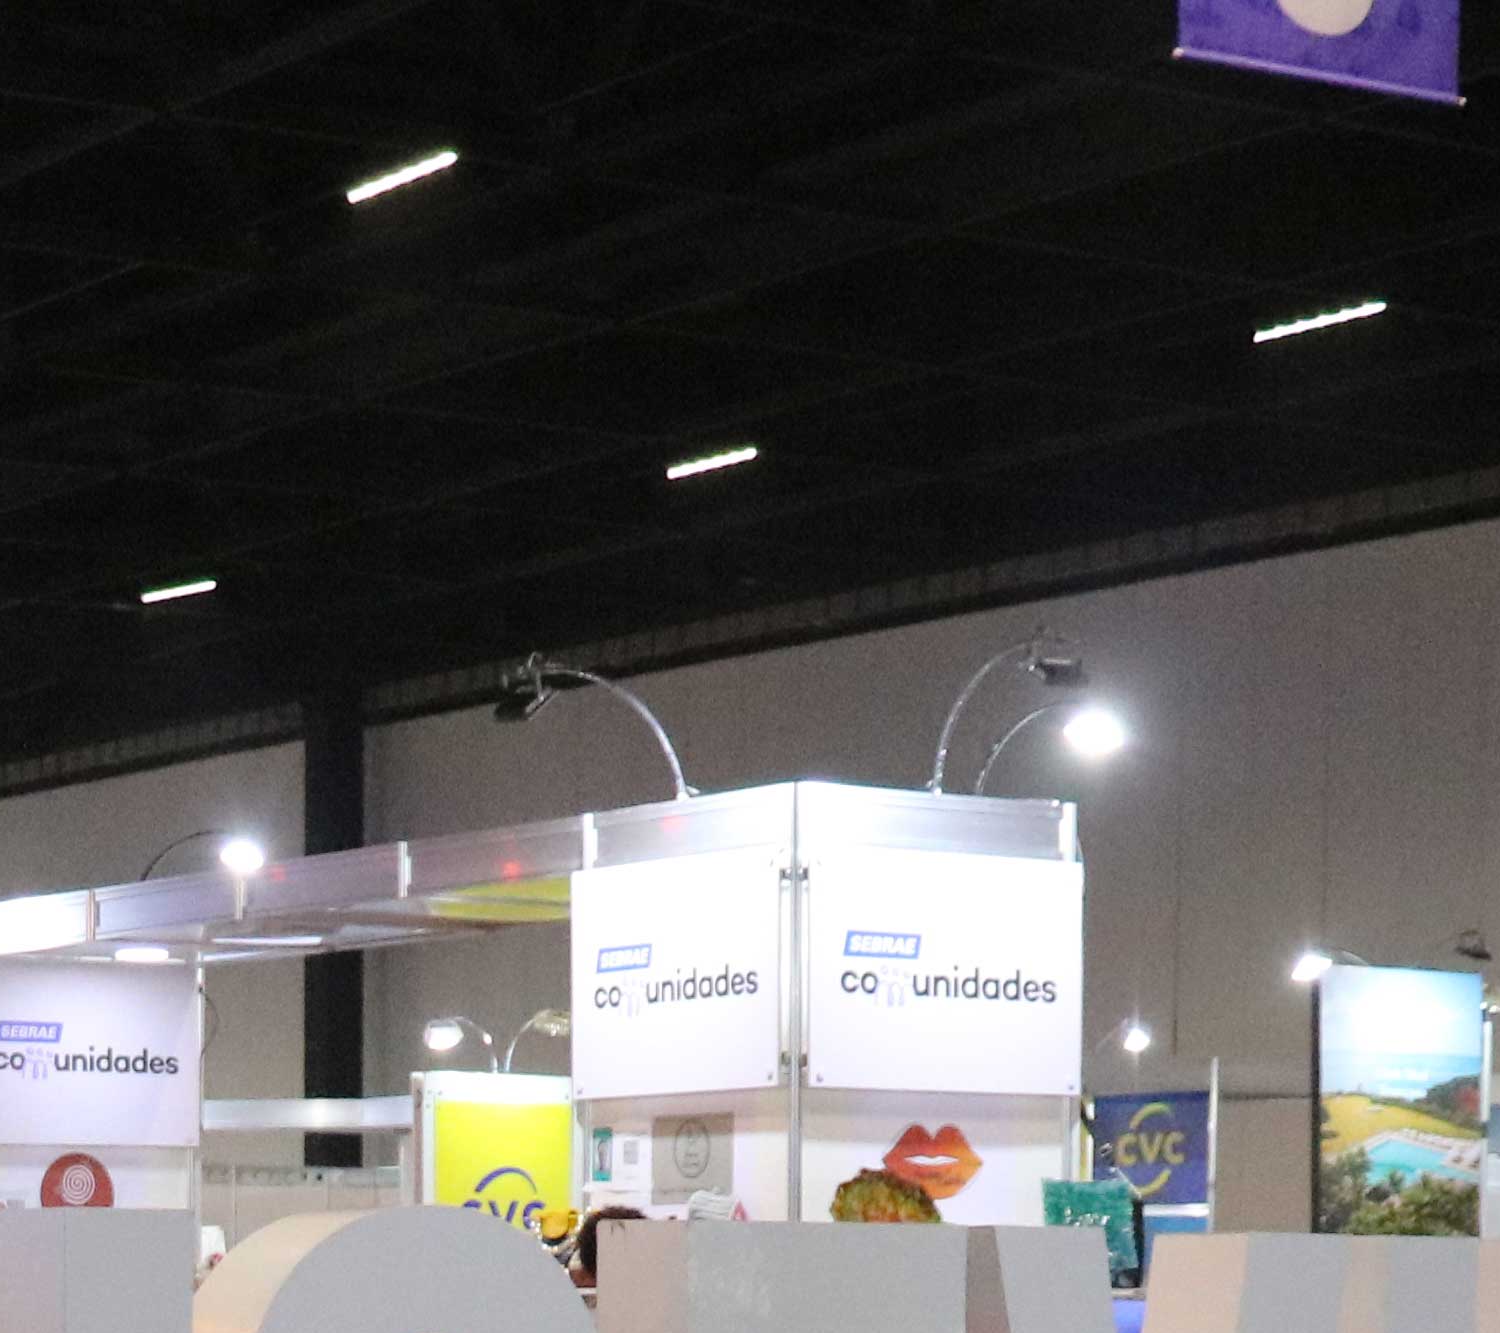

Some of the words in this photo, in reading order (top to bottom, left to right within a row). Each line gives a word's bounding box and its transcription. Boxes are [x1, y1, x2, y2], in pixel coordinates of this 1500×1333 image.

[848, 934, 918, 956] SEBRAE
[599, 947, 649, 969] SEBRAE
[0, 1025, 59, 1040] SEBRAE
[1115, 1131, 1185, 1165] CVC
